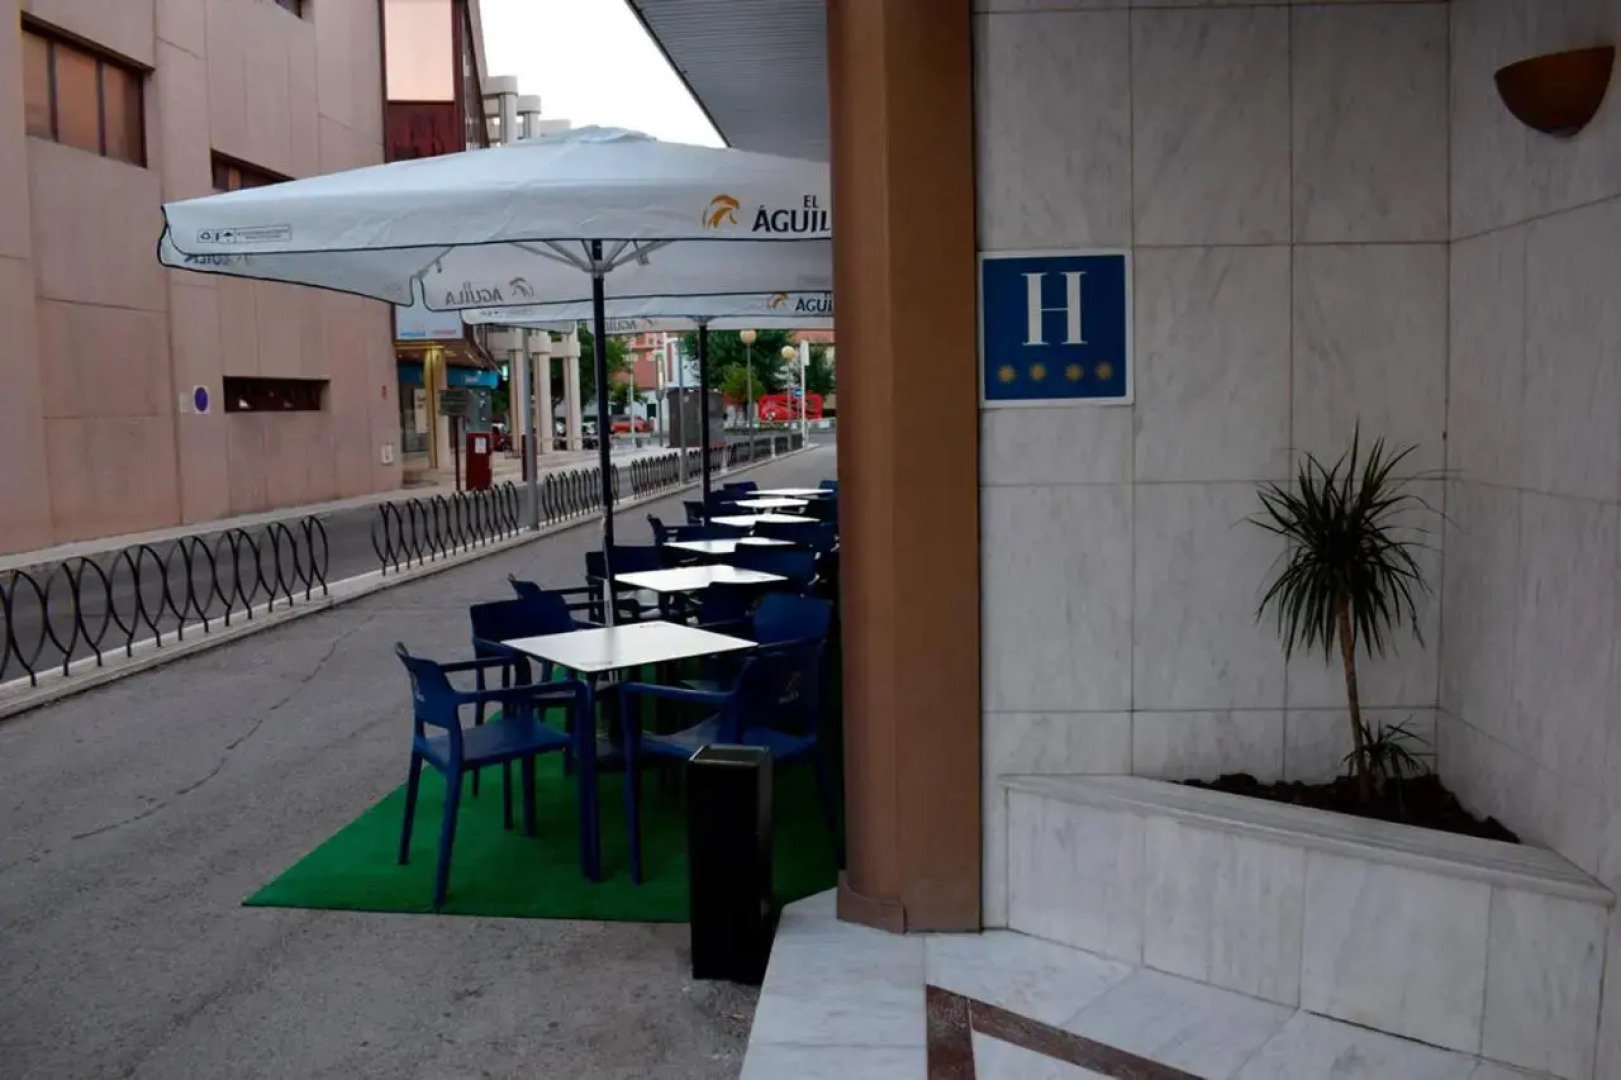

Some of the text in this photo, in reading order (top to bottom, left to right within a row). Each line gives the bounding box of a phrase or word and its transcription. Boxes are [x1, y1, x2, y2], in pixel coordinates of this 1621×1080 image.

[803, 195, 819, 208] EL
[751, 205, 832, 233] ÁGUIL
[795, 298, 832, 312] AGUI
[1020, 270, 1088, 346] H
